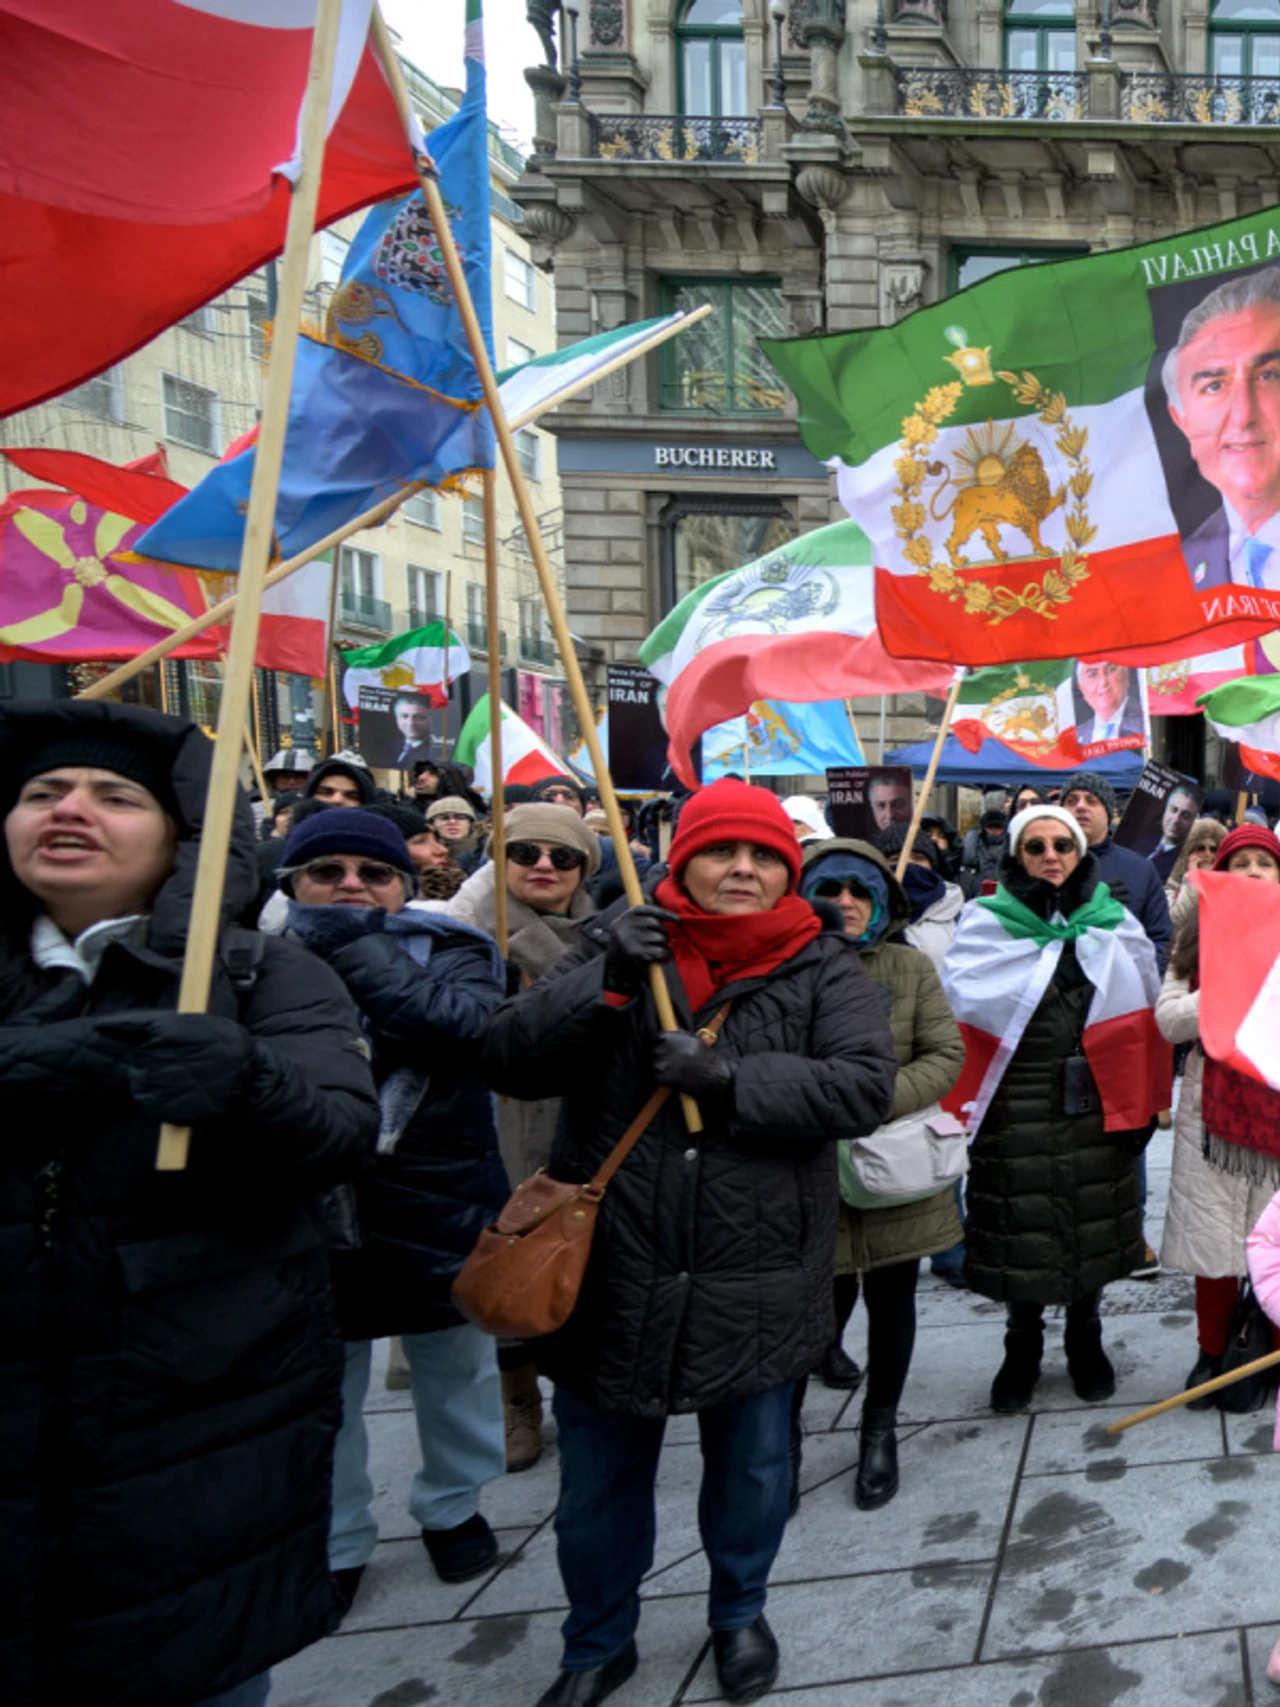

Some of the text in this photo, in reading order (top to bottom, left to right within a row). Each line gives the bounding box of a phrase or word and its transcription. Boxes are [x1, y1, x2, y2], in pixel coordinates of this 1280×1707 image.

[655, 447, 776, 468] BUCHERER
[609, 687, 650, 704] IRAN
[832, 791, 864, 805] IRAN
